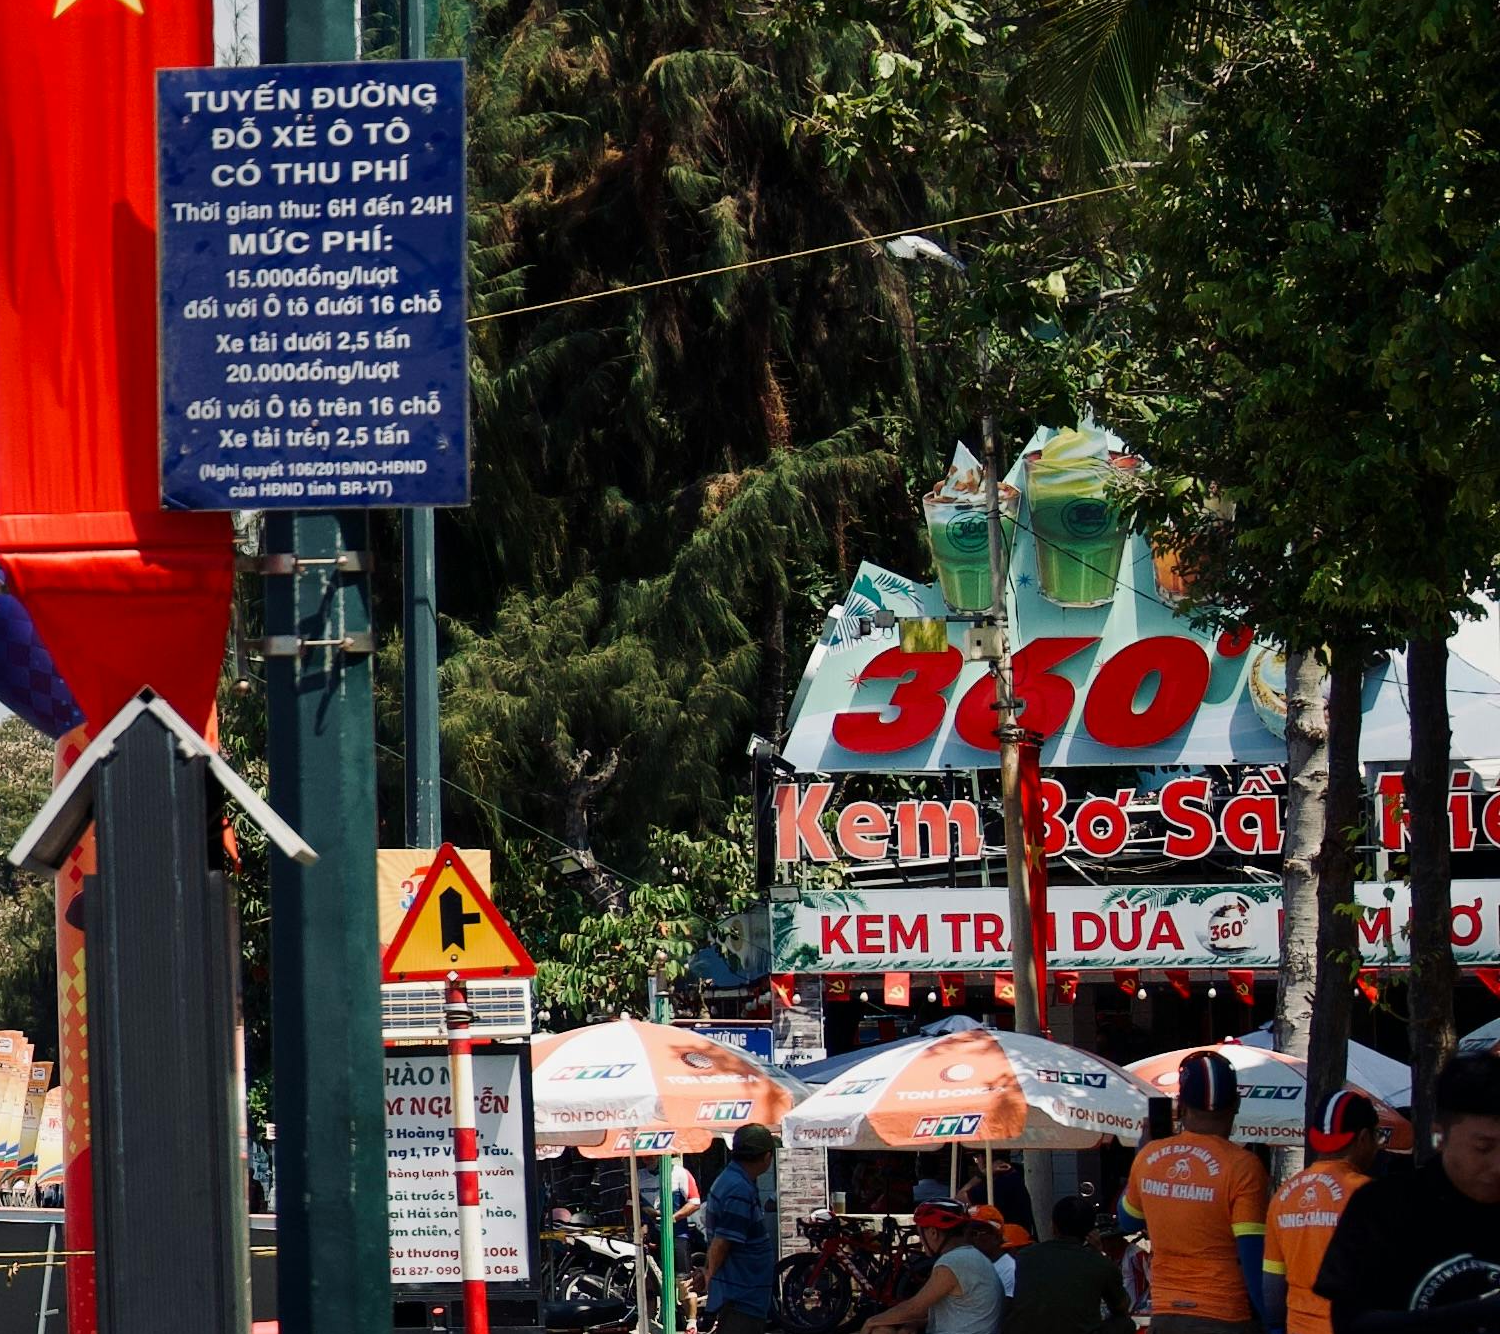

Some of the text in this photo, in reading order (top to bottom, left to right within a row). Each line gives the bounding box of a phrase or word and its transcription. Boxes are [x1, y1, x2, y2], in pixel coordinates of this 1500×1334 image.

[185, 80, 437, 113] TUYẾN ĐƯỜNG
[212, 117, 261, 149] ĐỖ
[328, 118, 353, 146] Ô
[362, 117, 410, 145] TÔ
[211, 154, 409, 187] CÓ THU PHÍ
[172, 194, 452, 224] Thời gian thu: 6H đến 24H
[229, 224, 393, 255] MỨC PHÍ:
[226, 264, 399, 290] 15.000đồng/lượt
[184, 296, 218, 318] đối
[225, 299, 257, 317] với
[263, 293, 280, 316] Ô
[287, 298, 308, 316] tô
[370, 295, 394, 314] 16
[400, 289, 442, 313] chỗ
[216, 327, 410, 353] Xe tải dưới 2,5 tấn
[226, 359, 400, 384] 20.000đồng/lượt
[186, 390, 441, 419] đối với Ô tô trên 16 chỗ
[219, 423, 409, 448] Xe tải trên 2,5 tấn
[772, 782, 985, 862] Kem
[1160, 767, 1286, 861] Sầ
[821, 913, 930, 955] KEM
[941, 911, 1057, 955] TRI
[1072, 900, 1185, 952] DỪA
[386, 1062, 434, 1086] HÀO
[410, 1087, 509, 1118] NGỄN
[699, 1101, 751, 1120] HTV
[397, 1126, 444, 1140] Hoàng
[917, 1116, 979, 1136] HTV
[423, 1147, 439, 1156] TP
[388, 1168, 419, 1179] hòng
